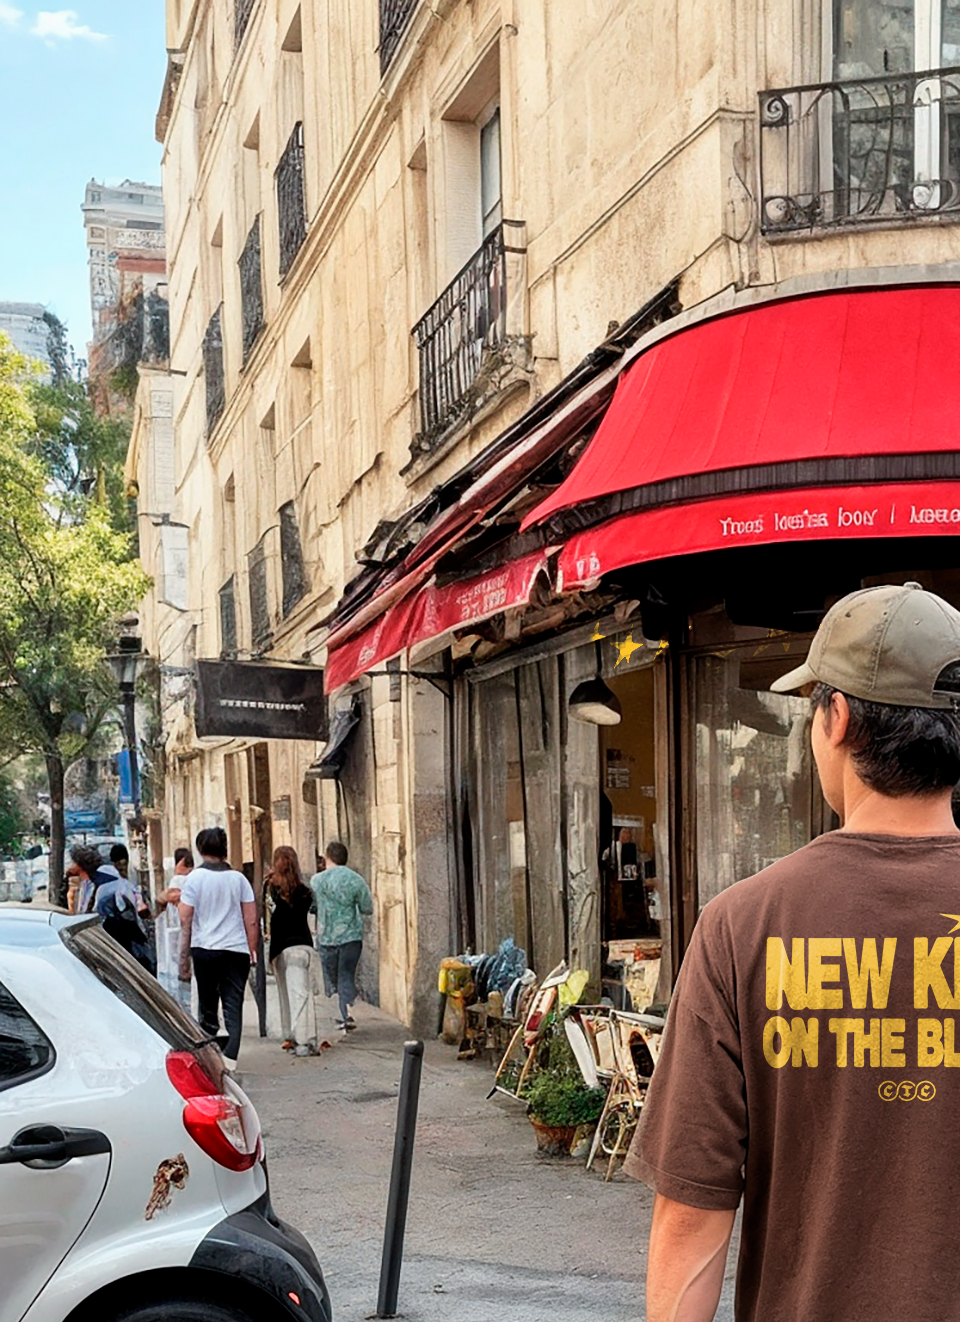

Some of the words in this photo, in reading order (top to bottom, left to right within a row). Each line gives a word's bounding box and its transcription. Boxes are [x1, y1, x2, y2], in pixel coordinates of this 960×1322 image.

[766, 936, 897, 1010] NEW
[763, 1016, 818, 1069] ON
[829, 1018, 906, 1067] THE
